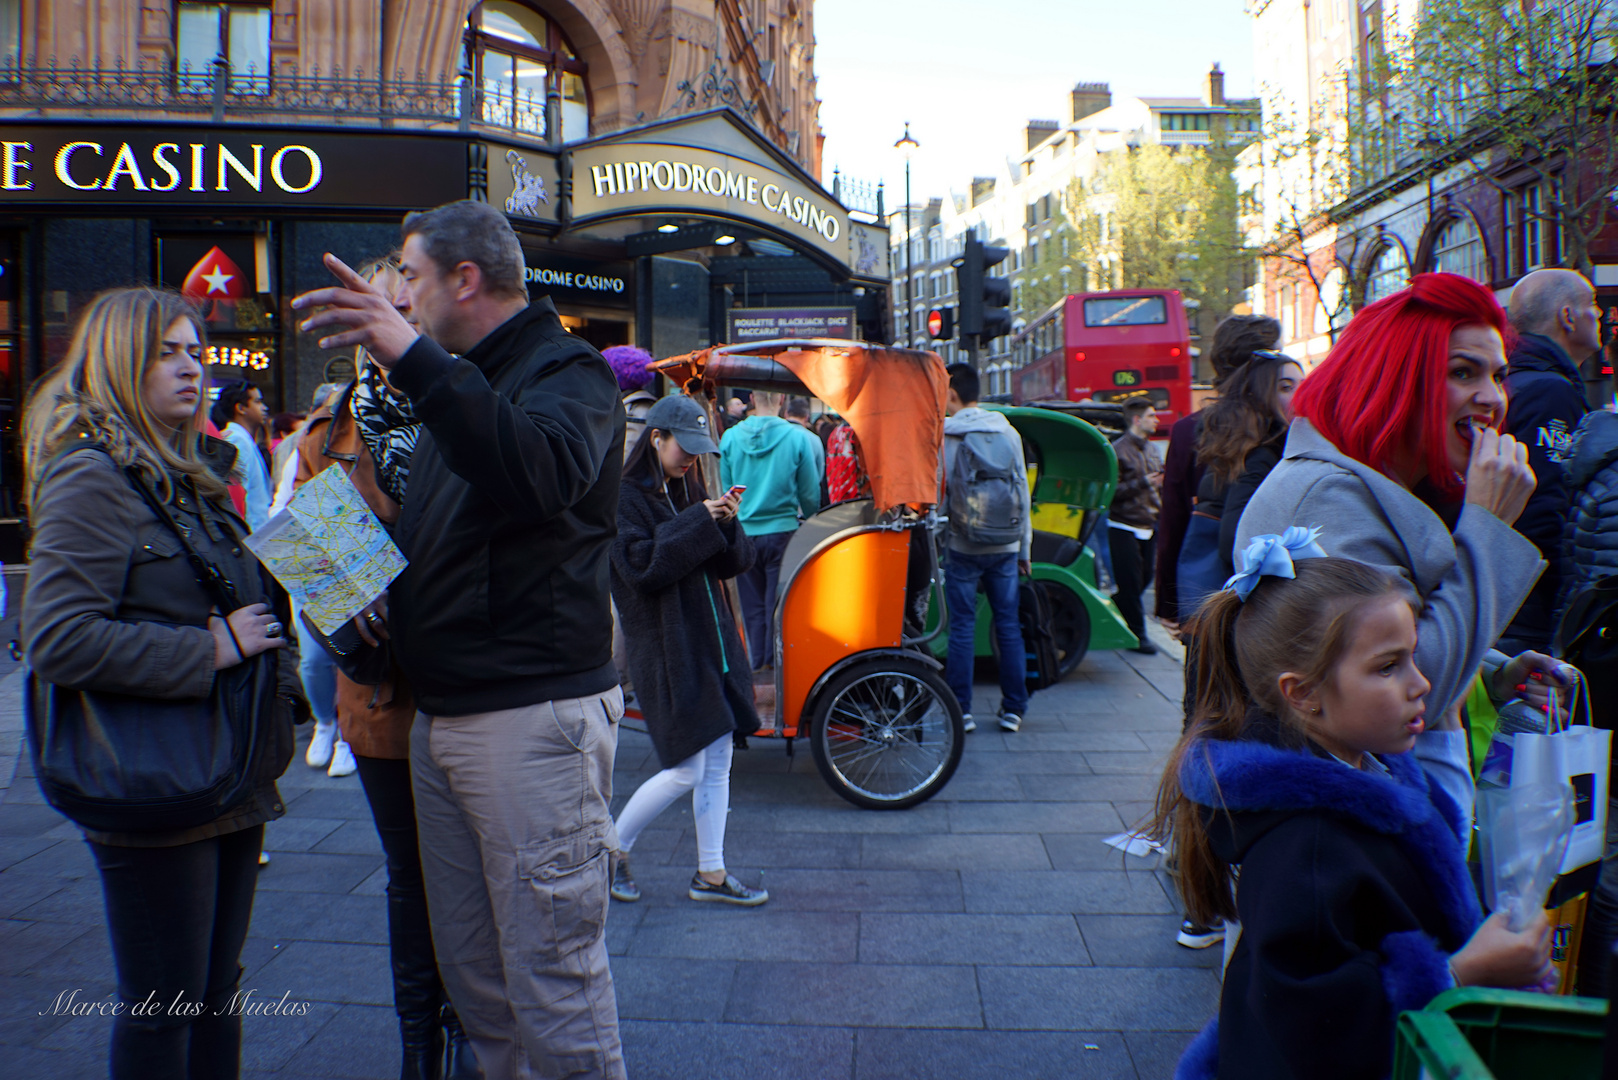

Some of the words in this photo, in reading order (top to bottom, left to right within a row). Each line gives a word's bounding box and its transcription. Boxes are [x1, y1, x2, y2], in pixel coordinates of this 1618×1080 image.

[54, 141, 323, 194] CASINO
[589, 160, 758, 205] HIPPODROME
[761, 183, 840, 243] CASINO
[524, 267, 573, 287] DROME
[574, 273, 624, 293] CASINO
[735, 319, 775, 327] ROULETTE
[778, 317, 825, 326] BLACKJACK
[827, 317, 848, 326] DICE
[738, 328, 780, 336] BACCARAT
